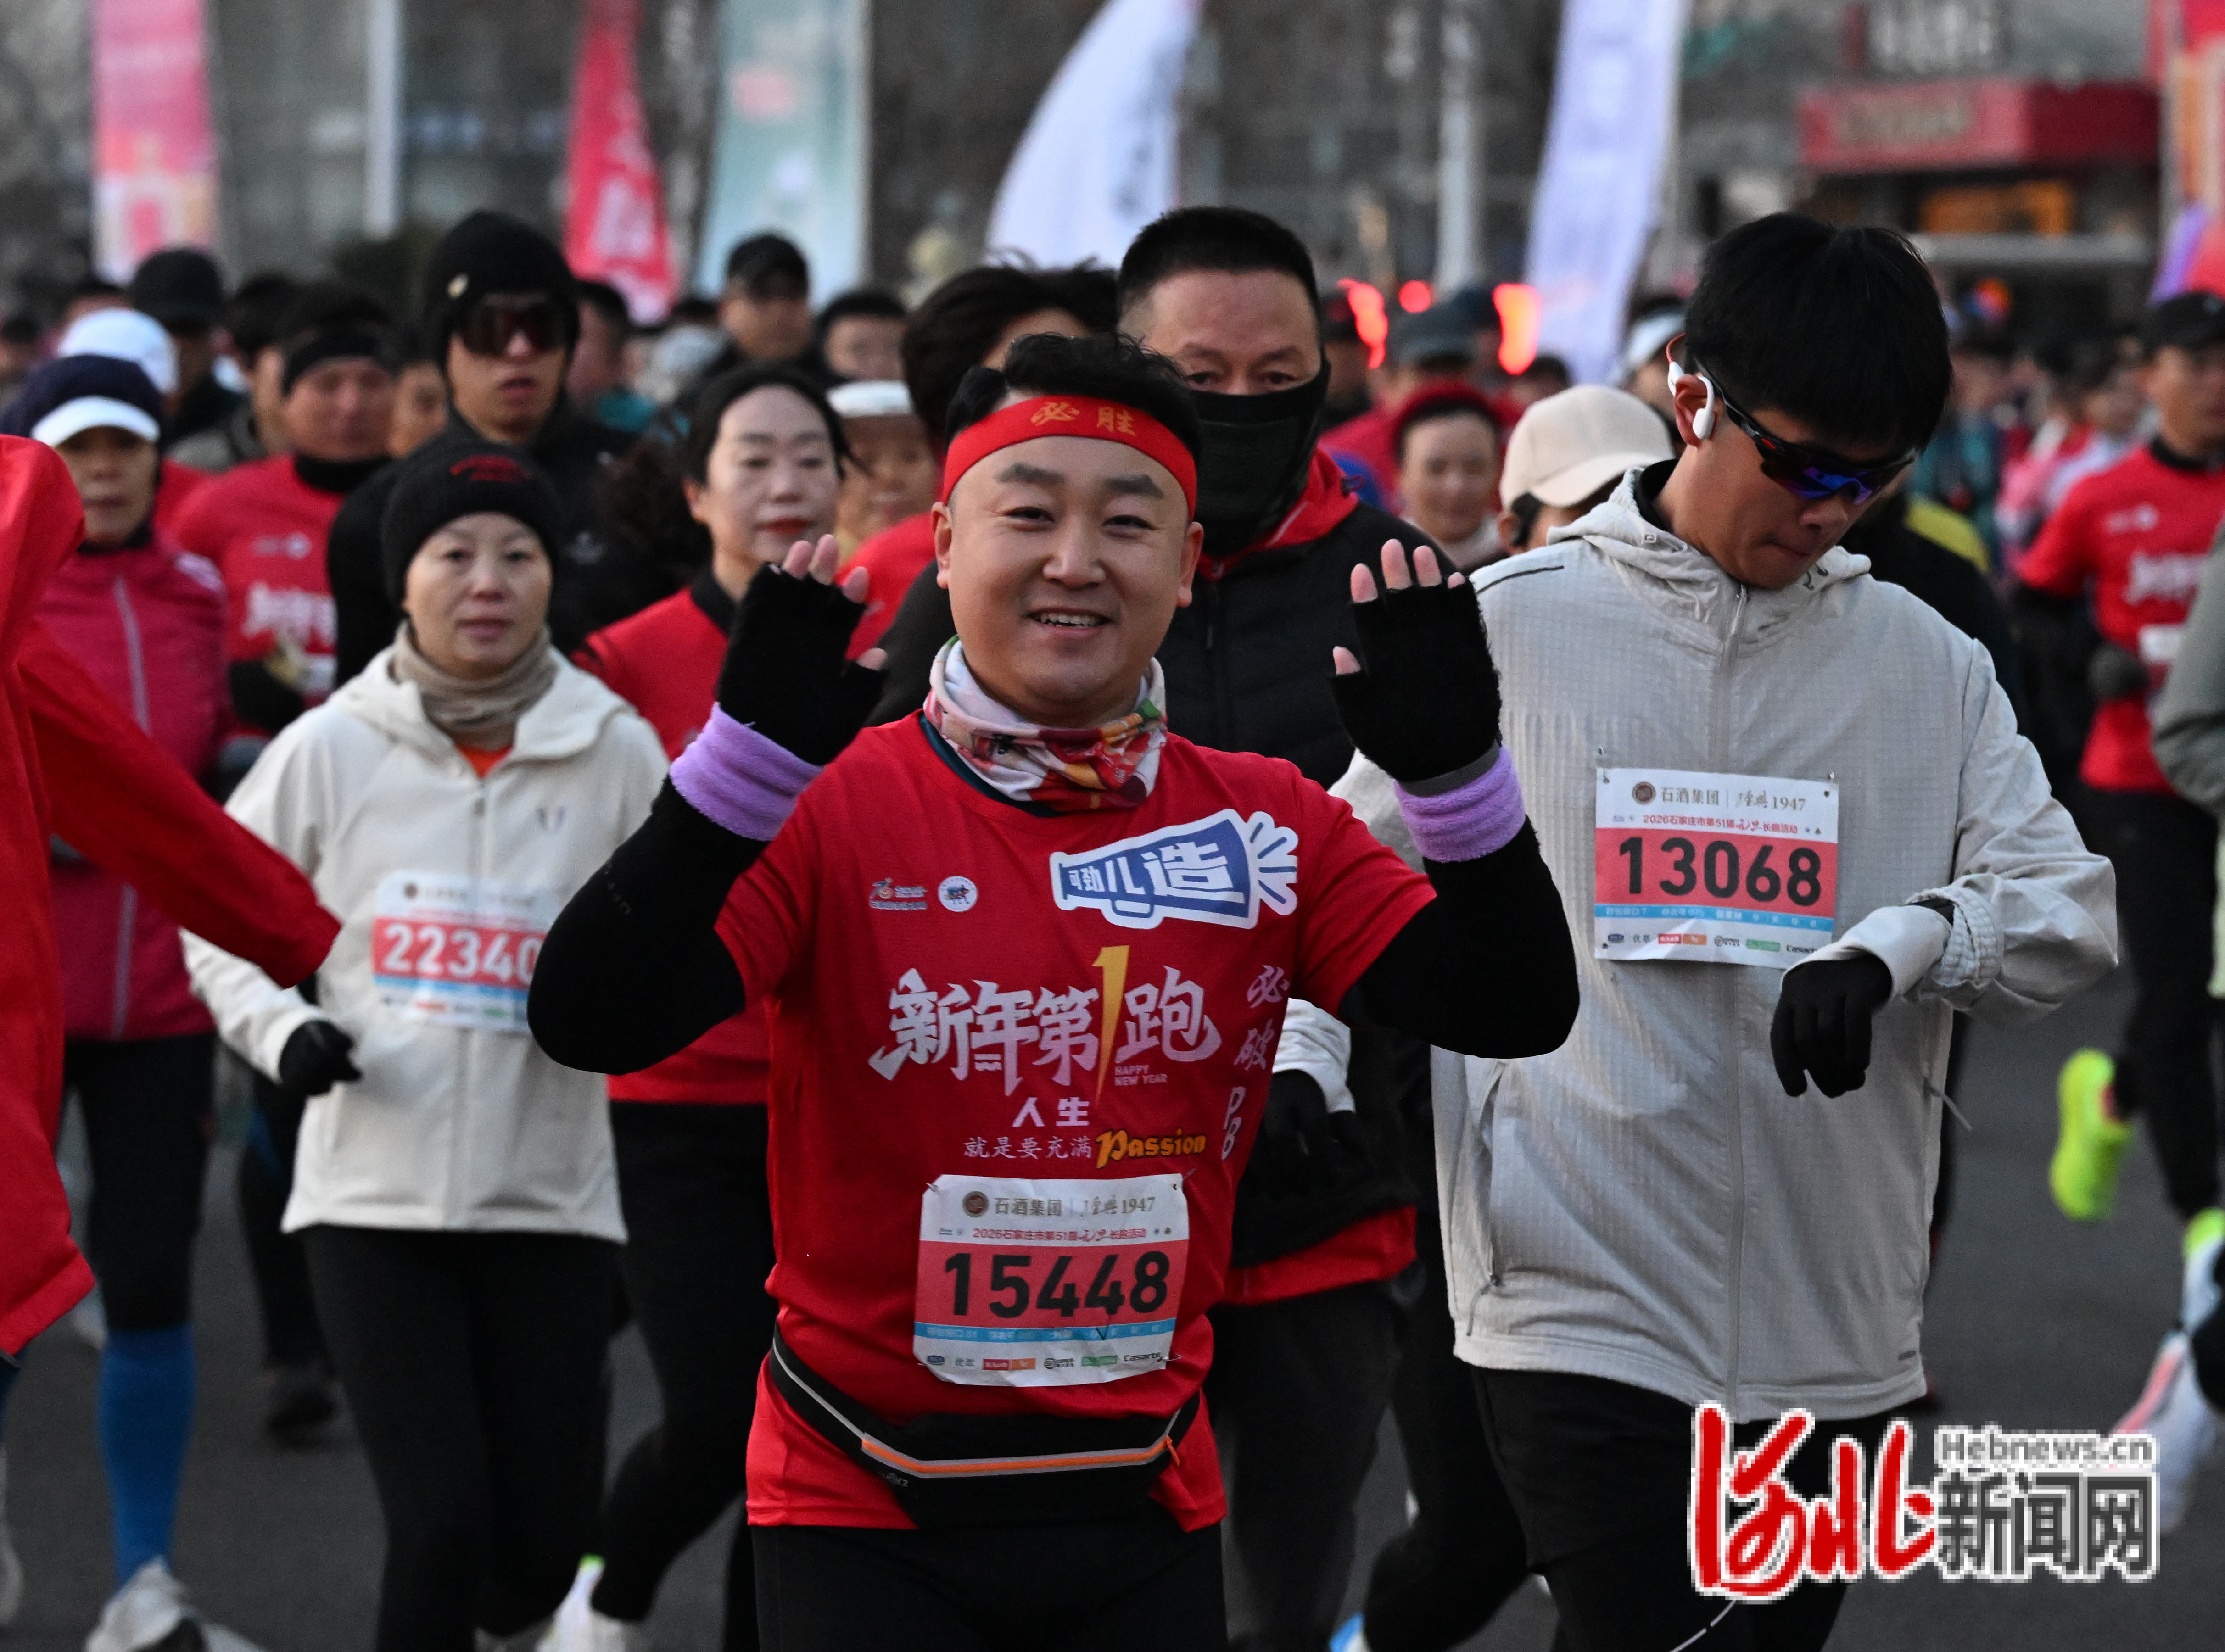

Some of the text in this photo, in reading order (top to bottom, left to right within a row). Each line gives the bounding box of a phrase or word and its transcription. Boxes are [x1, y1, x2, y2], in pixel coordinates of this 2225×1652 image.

[1030, 402, 1136, 437] 必胜
[1660, 787, 1720, 806] 石酒集团
[1068, 842, 1245, 904] 可劲儿造
[1619, 837, 1822, 907] 13068
[384, 923, 543, 986] 22340
[1114, 1064, 1151, 1076] HAPPY
[1114, 1076, 1140, 1086] NEW
[1012, 1097, 1090, 1127] 人生
[963, 1128, 1207, 1169] 就是要充满 Passion
[995, 1197, 1062, 1217] 石酒集团
[945, 1250, 1170, 1318] 15448
